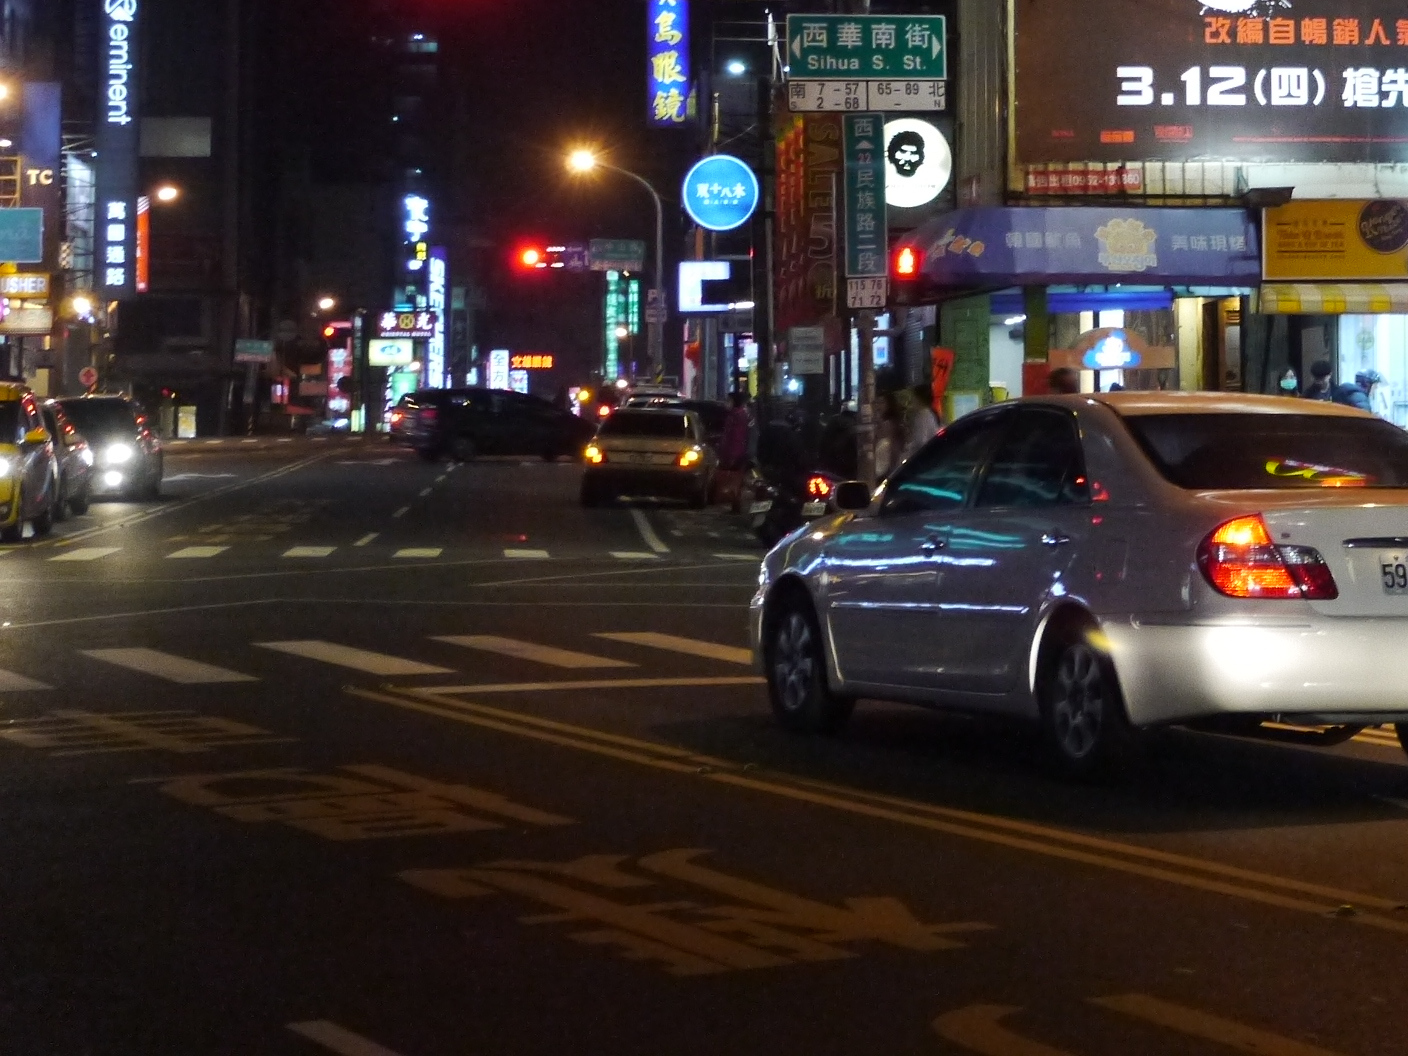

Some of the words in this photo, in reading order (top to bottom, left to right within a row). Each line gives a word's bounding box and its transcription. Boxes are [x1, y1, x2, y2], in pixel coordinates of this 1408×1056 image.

[802, 22, 931, 49] 西華南街
[807, 55, 860, 70] Sihua
[872, 55, 890, 70] S.
[903, 55, 927, 70] St.
[107, 23, 132, 126] eminent
[789, 82, 806, 99] 南
[928, 83, 945, 98] 北
[854, 118, 873, 137] 西
[856, 169, 879, 272] 民族路二段
